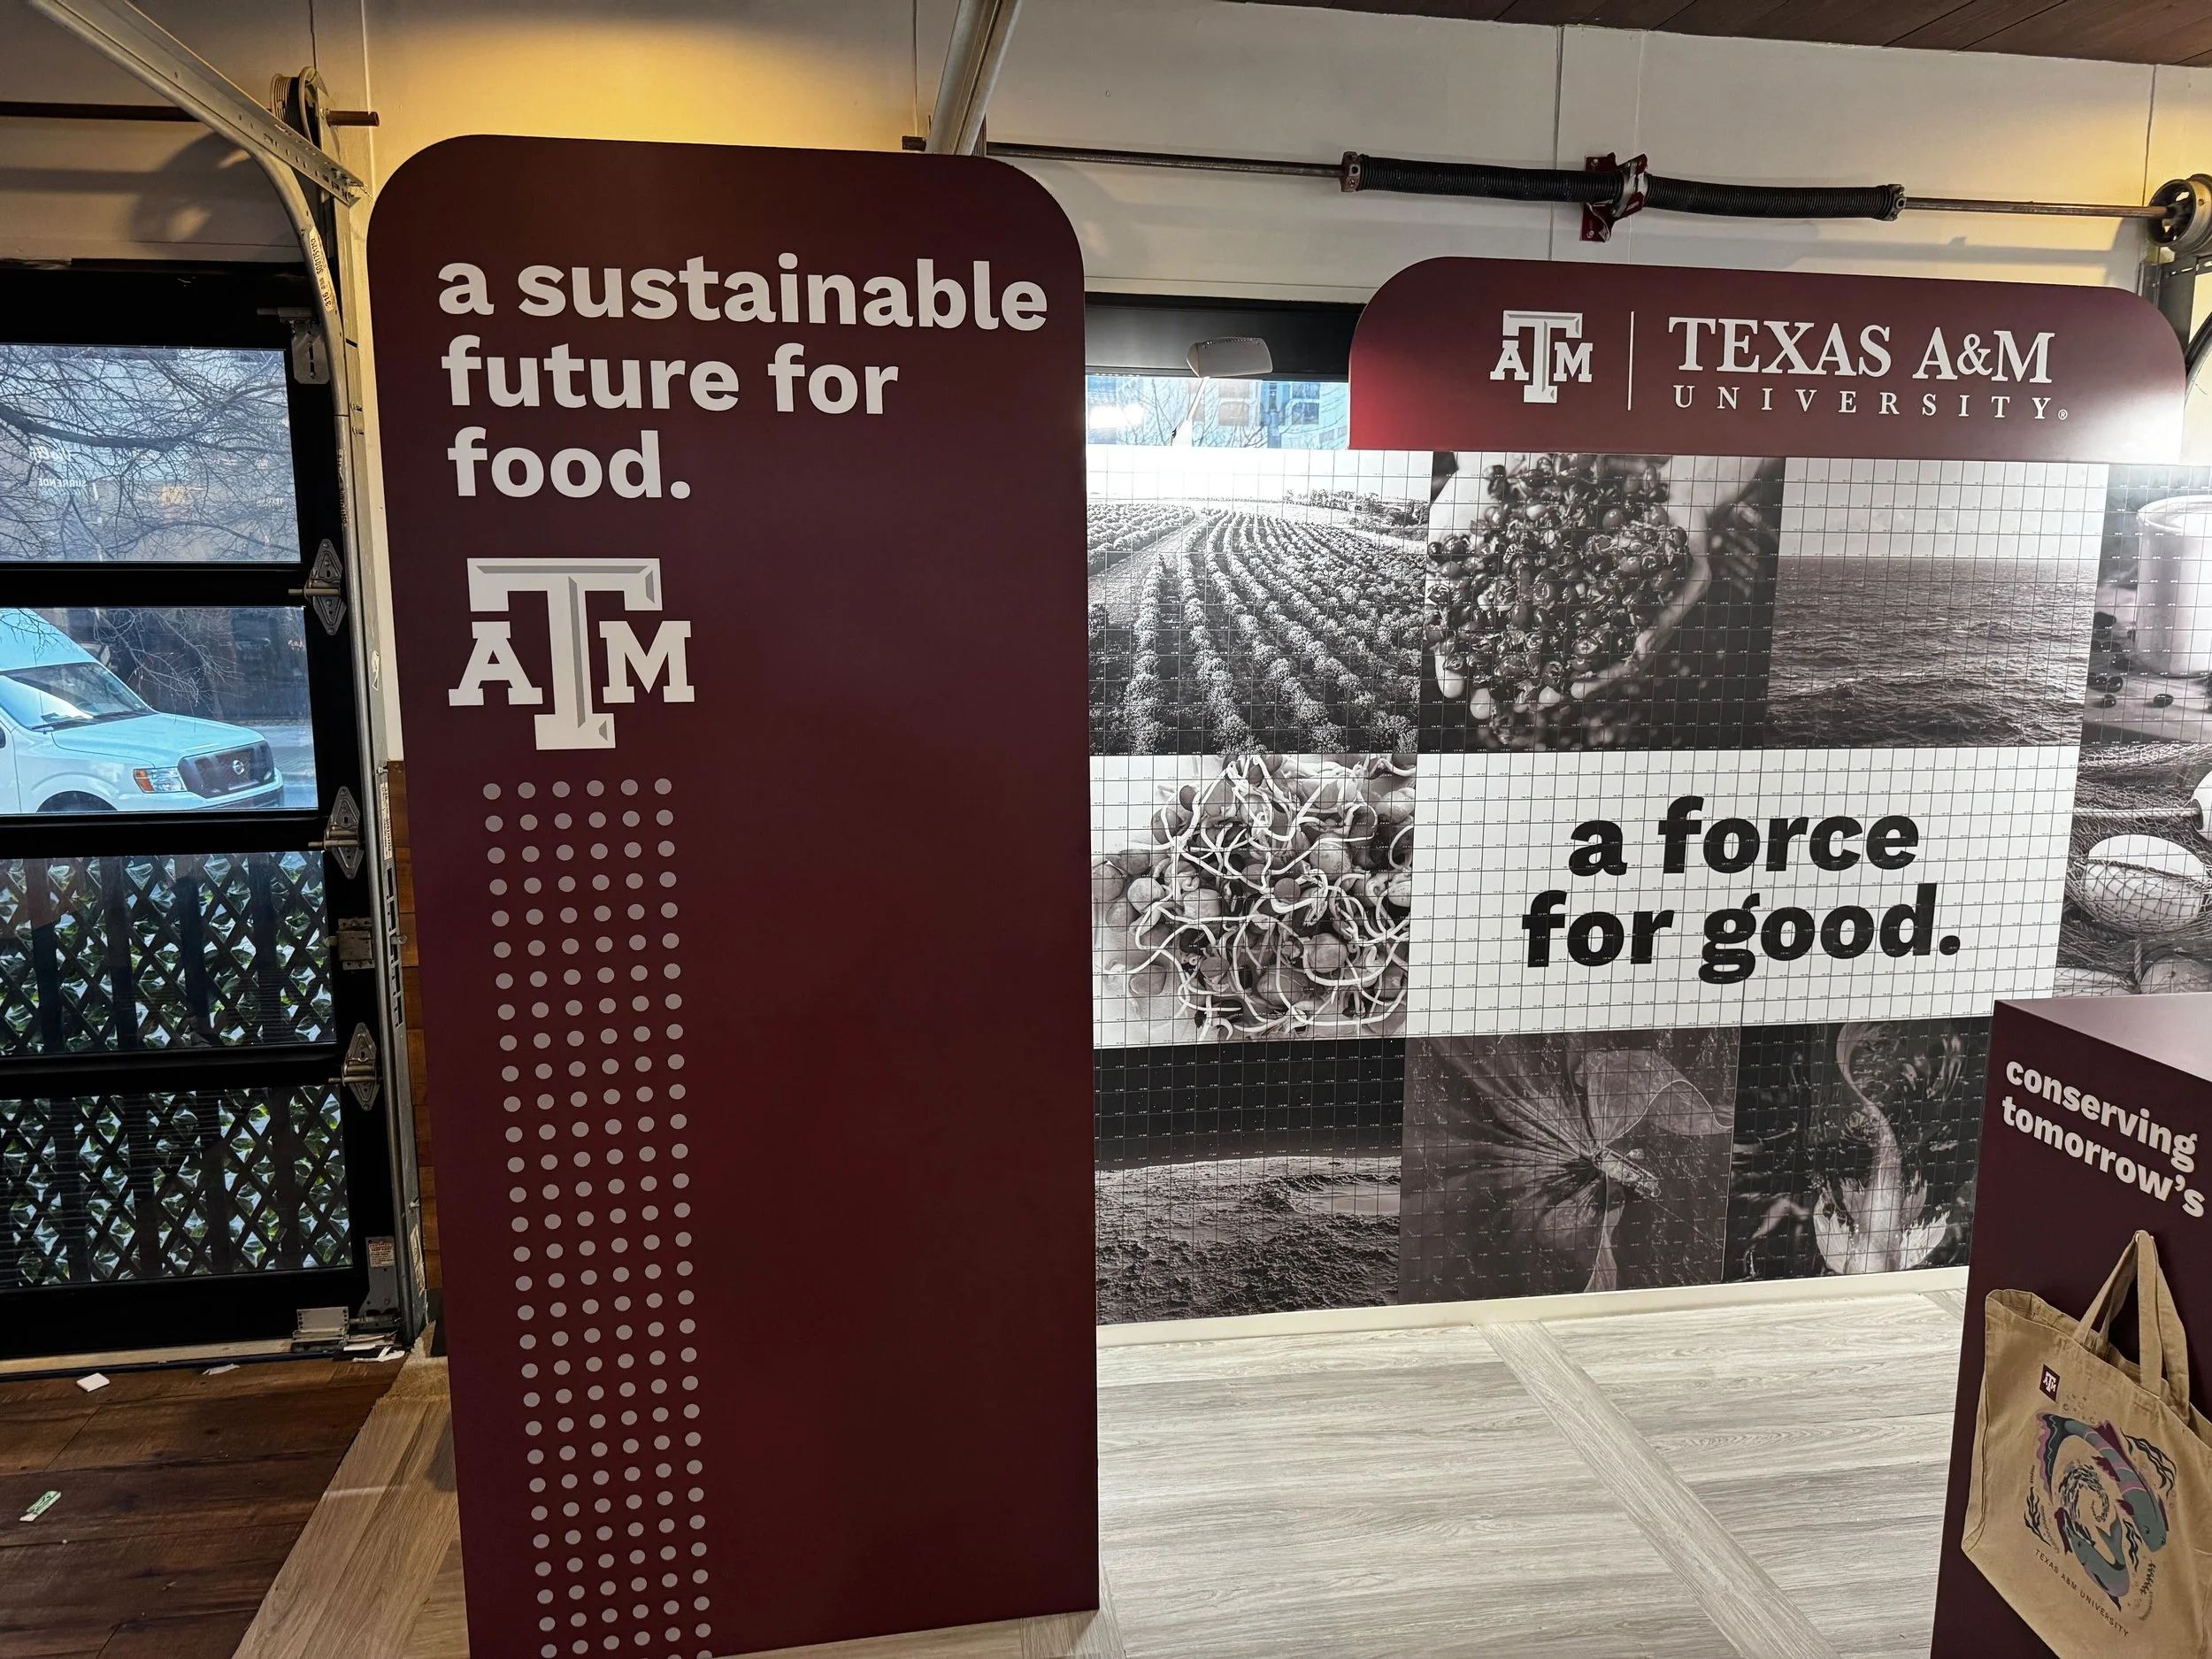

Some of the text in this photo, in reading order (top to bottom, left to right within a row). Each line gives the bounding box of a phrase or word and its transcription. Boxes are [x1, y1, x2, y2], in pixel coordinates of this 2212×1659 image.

[438, 252, 1048, 332] a sustainable
[442, 334, 899, 415] future for
[1668, 316, 2055, 384] TEXAS A&M
[447, 426, 692, 499] food.
[1568, 818, 1629, 877] a
[1657, 795, 1920, 875] force
[1521, 882, 1962, 985] for good.
[2006, 1061, 2199, 1173] conserving
[2035, 1548, 2129, 1637] TEXAS A&M UNIVERSITY
